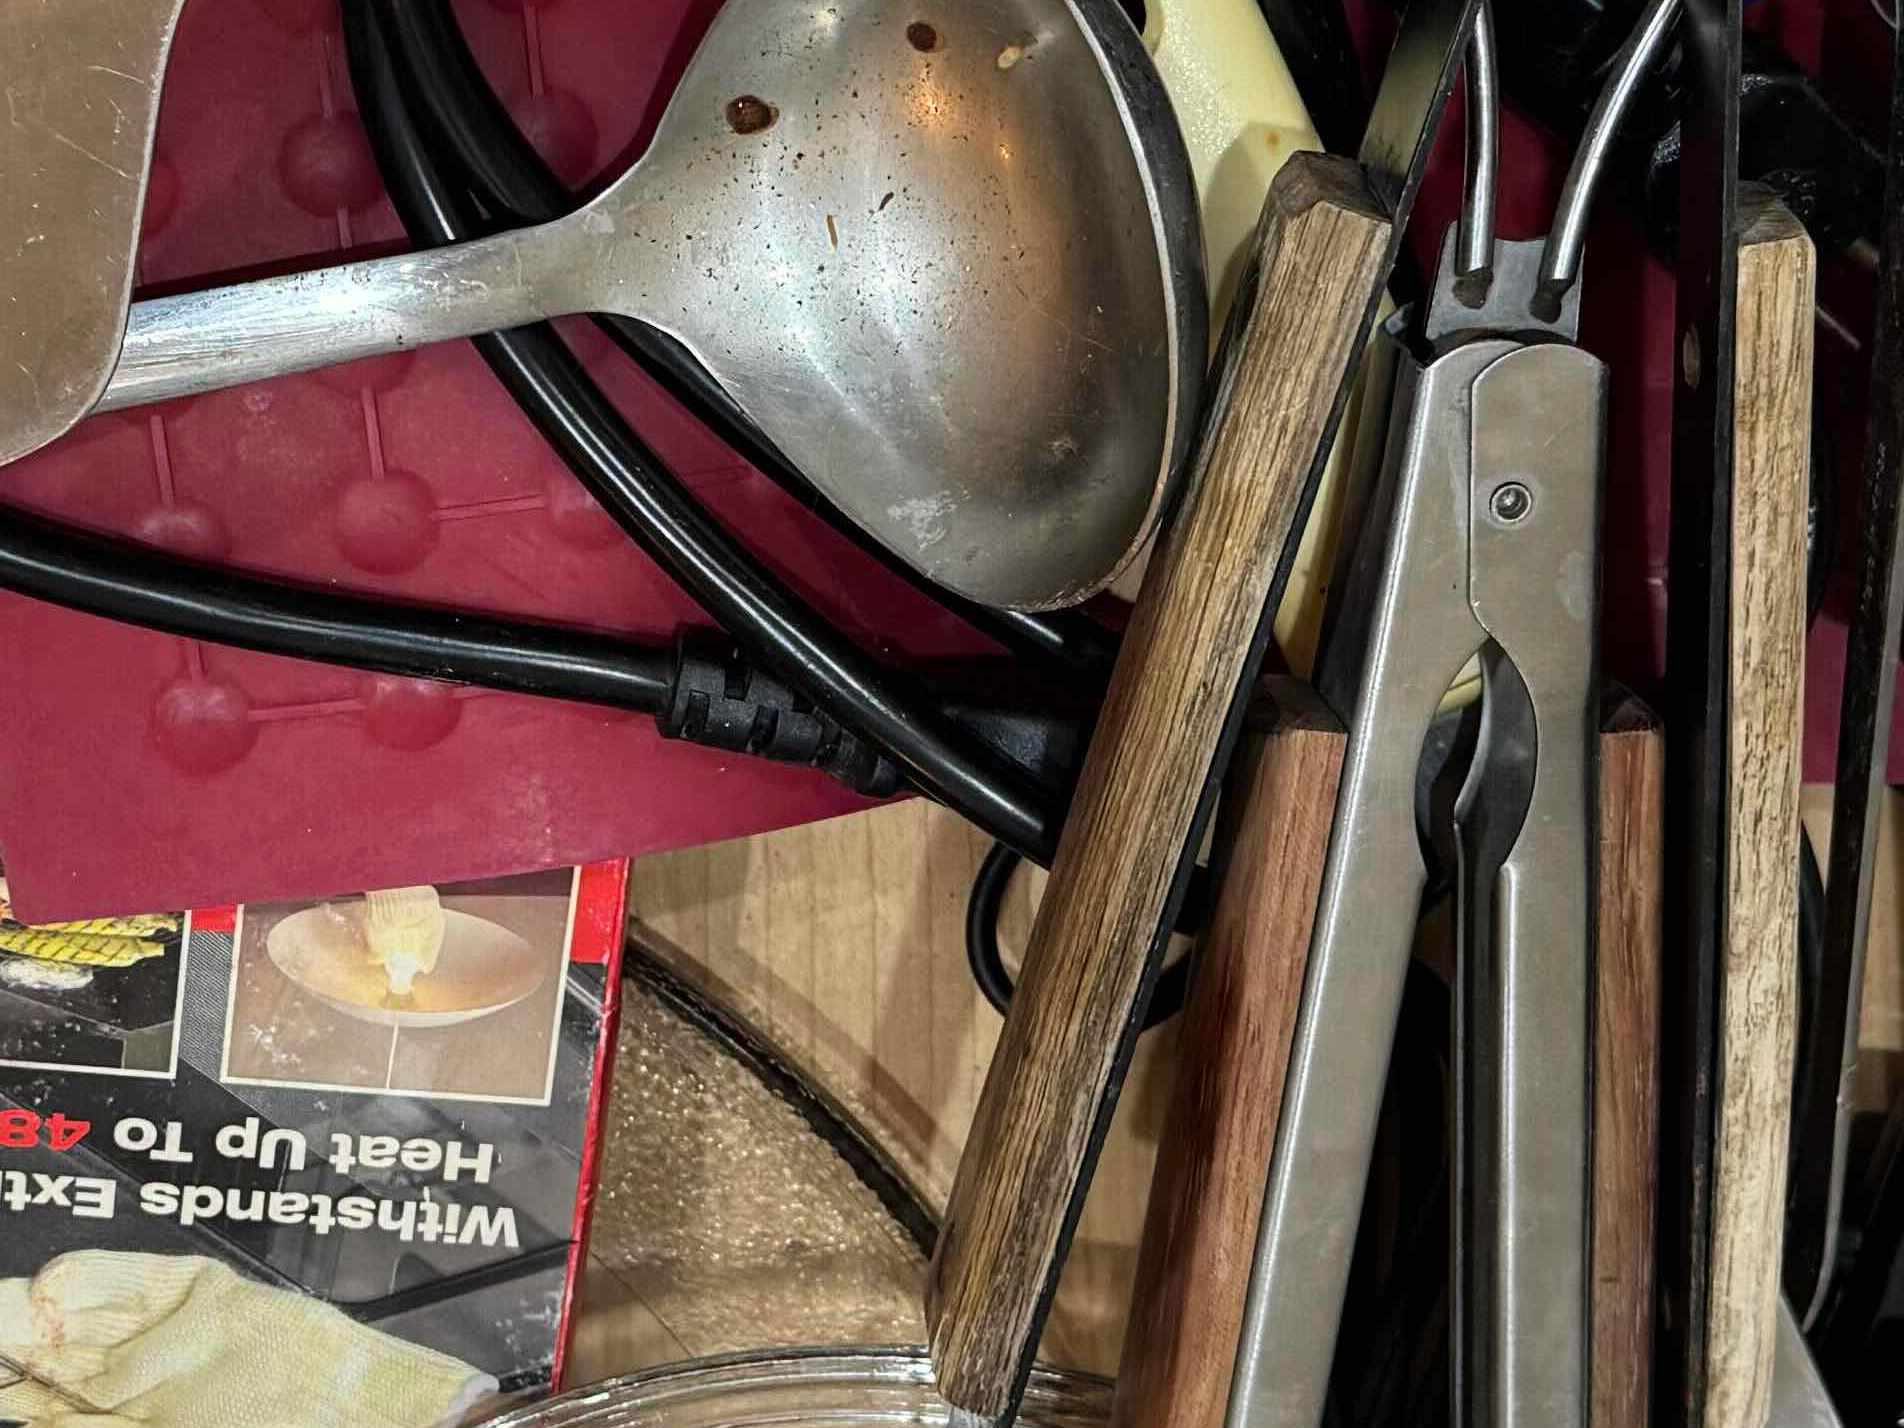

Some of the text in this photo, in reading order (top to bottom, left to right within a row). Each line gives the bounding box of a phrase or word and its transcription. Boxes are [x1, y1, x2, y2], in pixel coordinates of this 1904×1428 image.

[112, 1116, 193, 1162] To
[214, 1116, 307, 1171] Up
[329, 1131, 494, 1183] Heat
[140, 1183, 520, 1249] Withstands
